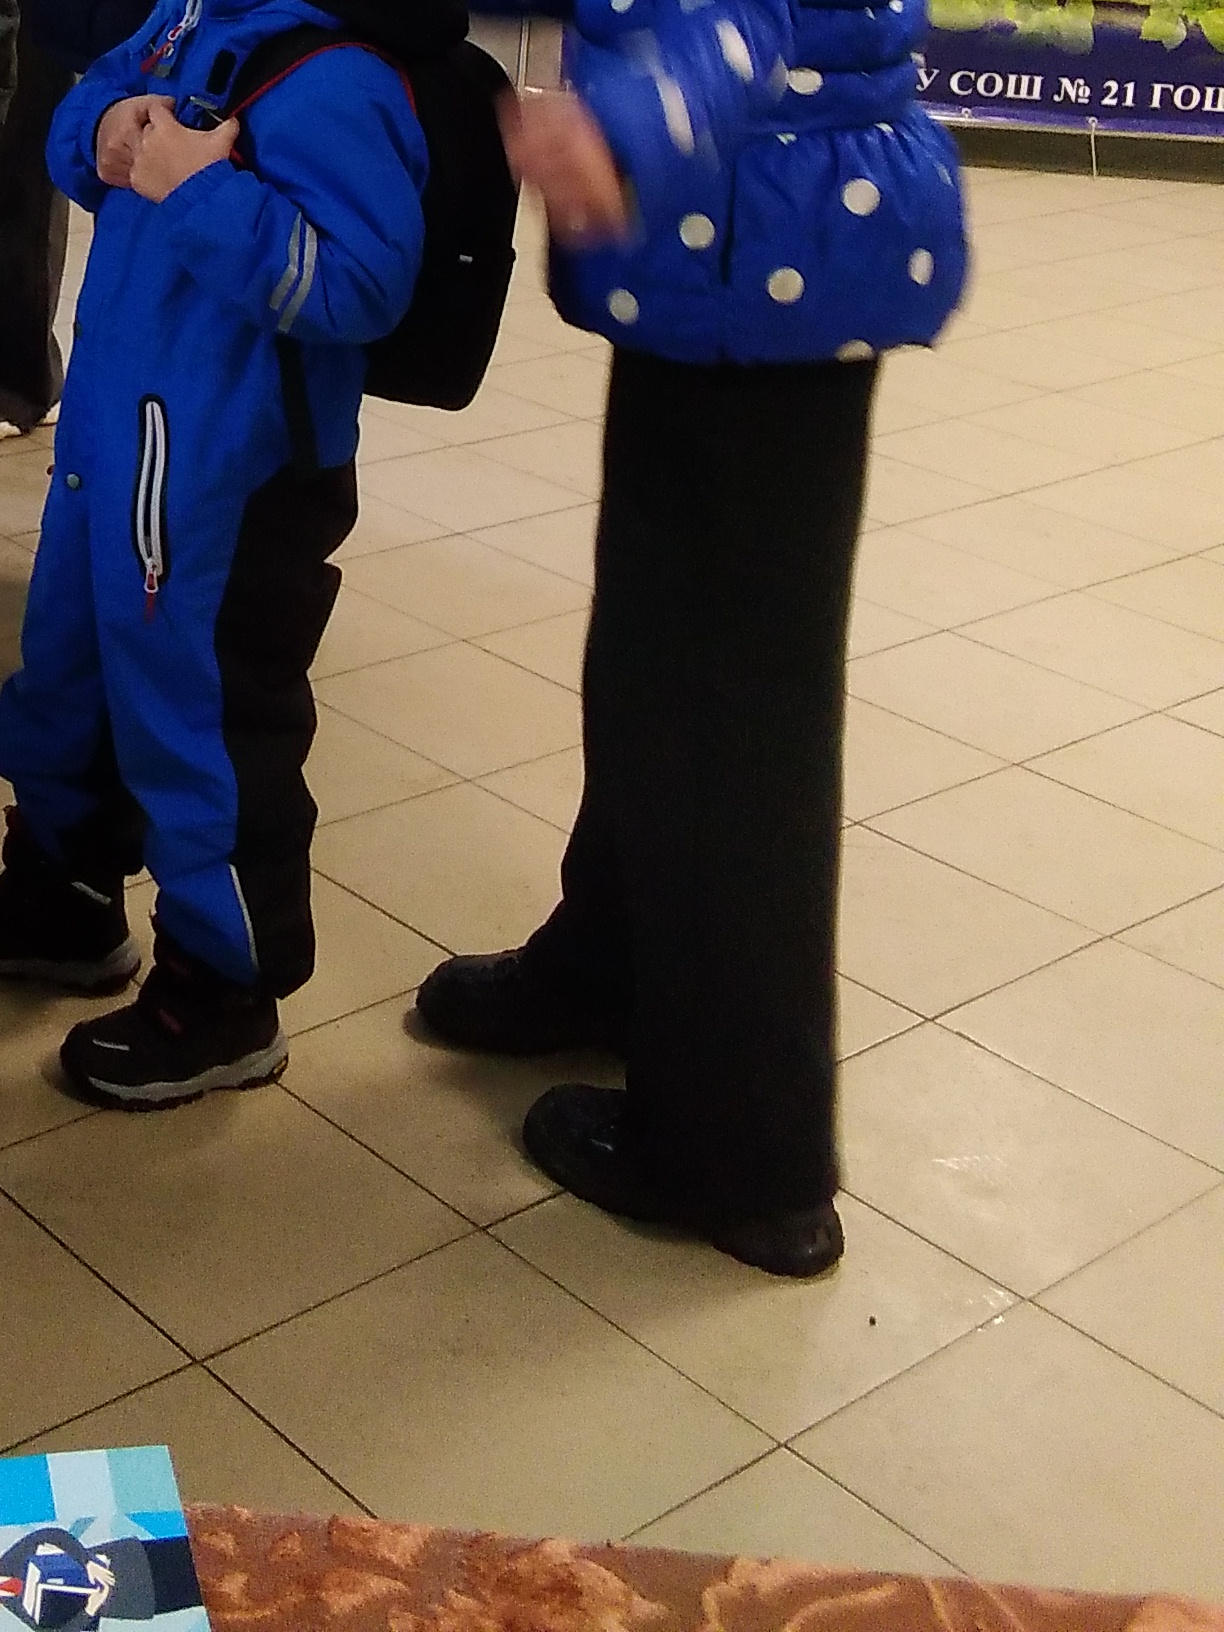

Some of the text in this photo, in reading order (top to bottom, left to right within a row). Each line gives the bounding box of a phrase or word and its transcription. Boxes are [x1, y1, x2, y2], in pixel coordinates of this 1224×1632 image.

[949, 70, 1044, 100] СОШ
[1053, 77, 1091, 104] №
[1101, 80, 1136, 107] 21
